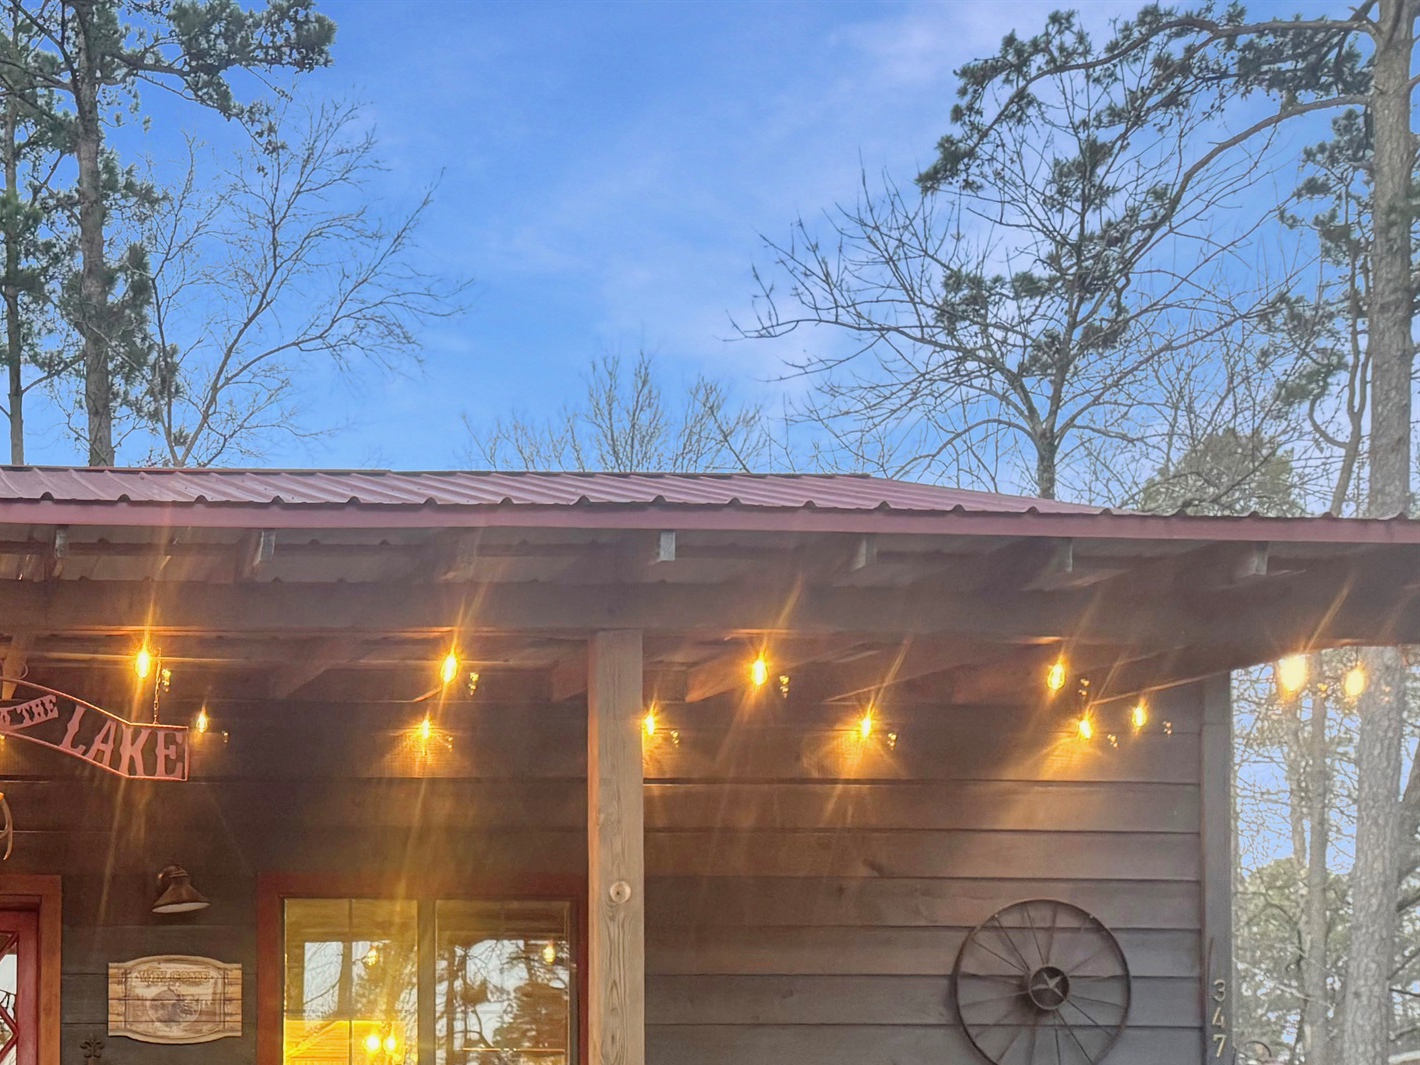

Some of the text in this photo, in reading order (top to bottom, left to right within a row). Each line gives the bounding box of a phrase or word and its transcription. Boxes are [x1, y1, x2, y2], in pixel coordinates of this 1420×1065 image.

[10, 694, 59, 725] THE
[59, 705, 187, 778] LAKE
[1212, 979, 1227, 1058] 347
